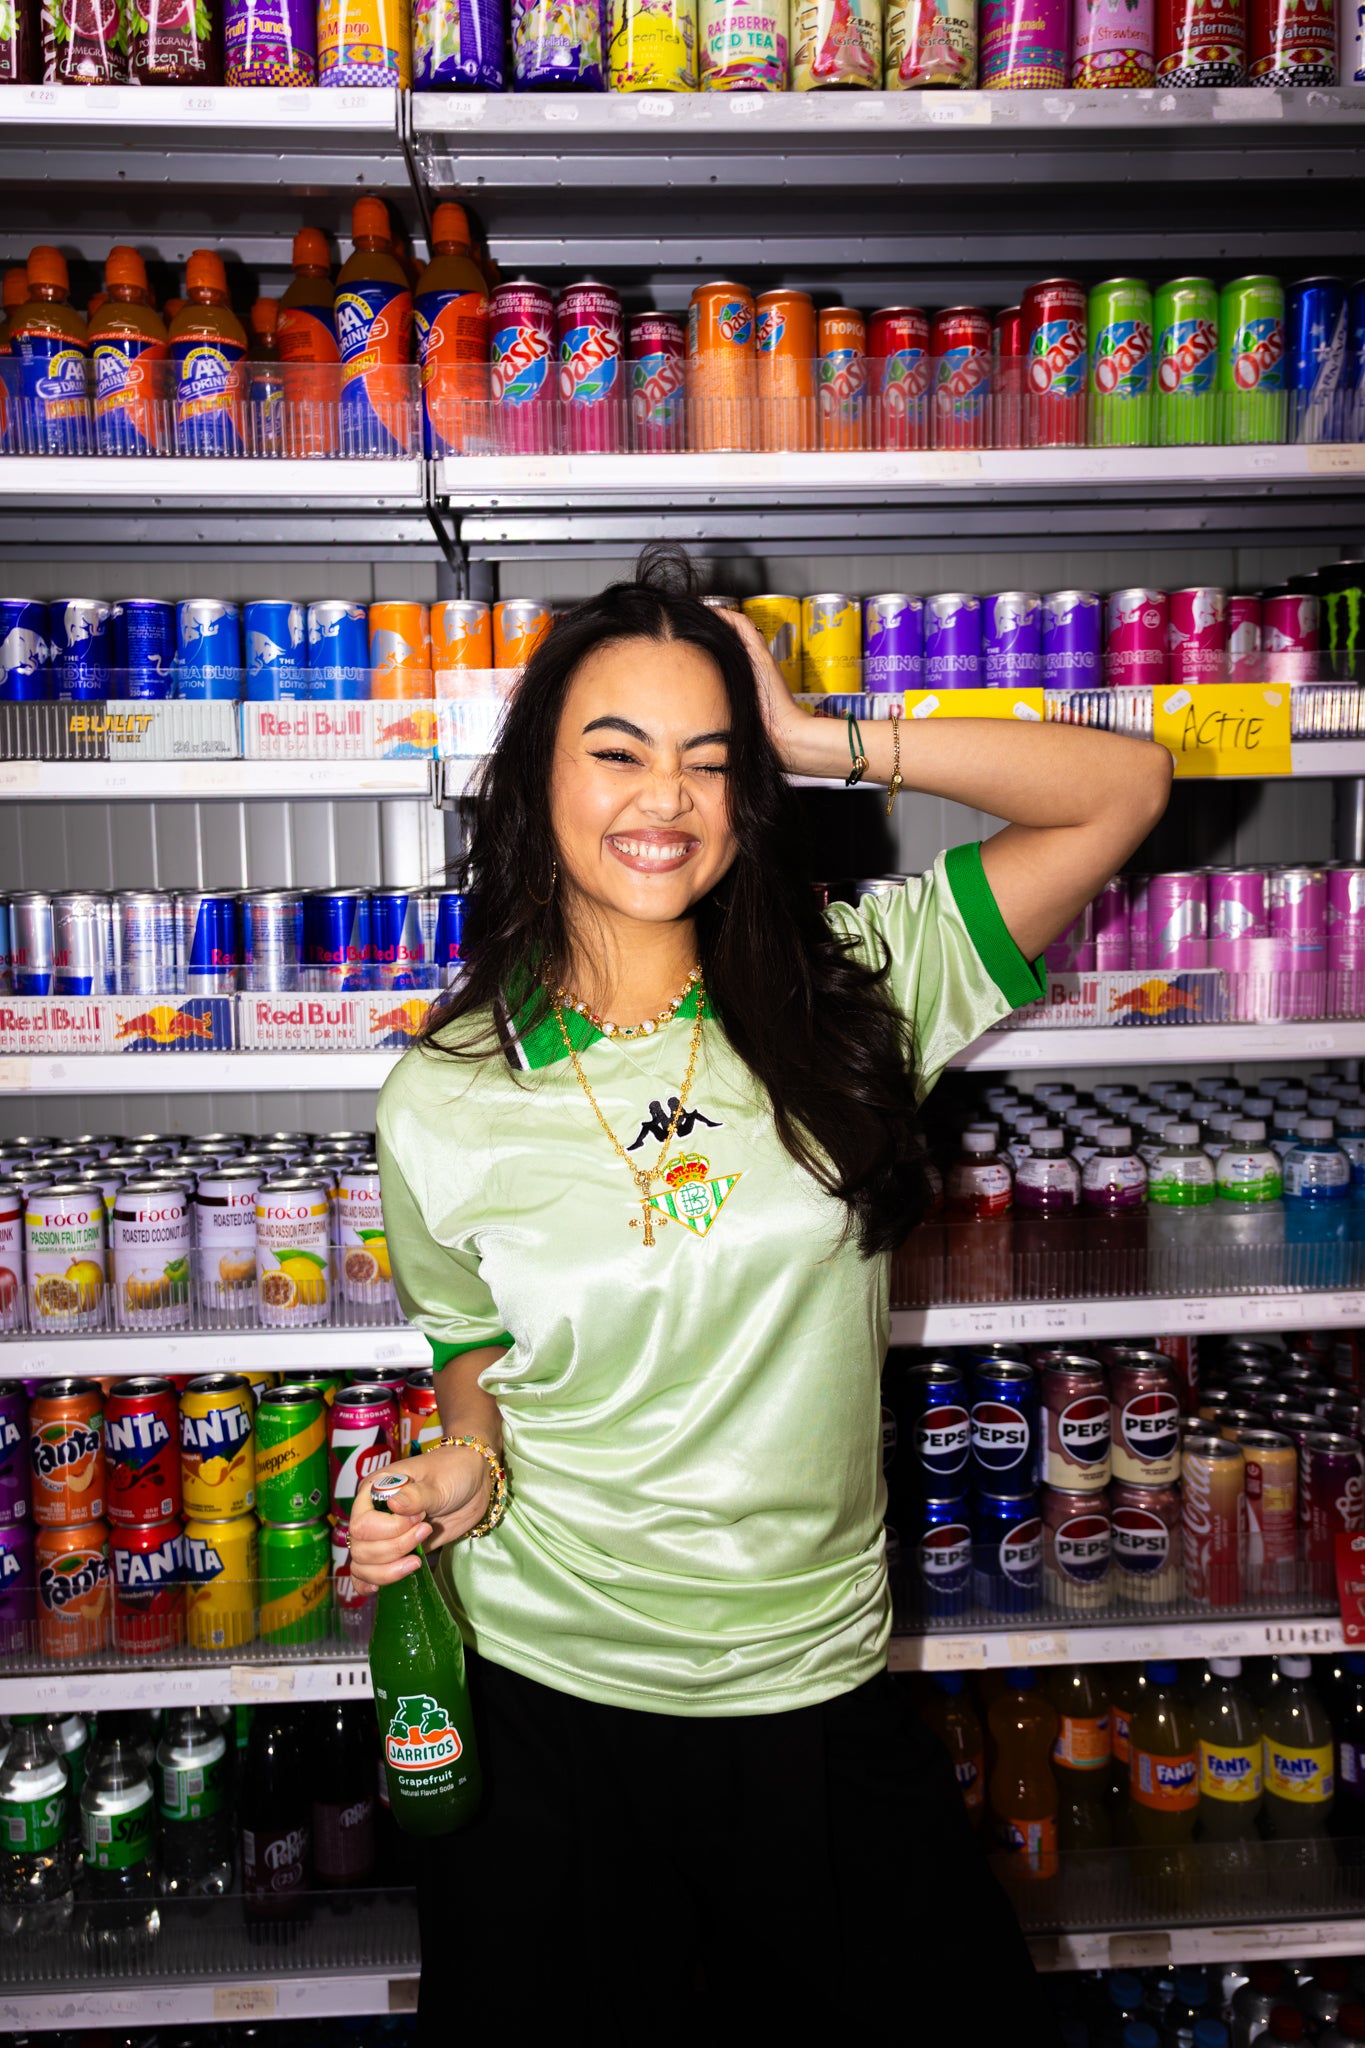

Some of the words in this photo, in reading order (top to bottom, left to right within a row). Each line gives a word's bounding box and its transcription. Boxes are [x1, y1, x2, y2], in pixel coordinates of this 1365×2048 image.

[934, 16, 969, 30] ZERO
[748, 33, 774, 50] TEA
[498, 298, 519, 308] CASSIS
[569, 298, 591, 309] CASSIS
[337, 305, 364, 340] AA
[98, 356, 122, 379] AA
[194, 358, 222, 379] AA
[490, 326, 550, 406] Oasis
[559, 326, 620, 405] Oasis
[191, 375, 229, 395] DRINK
[986, 647, 1000, 656] THE
[1182, 641, 1199, 649] THE
[63, 655, 79, 663] THE
[279, 657, 295, 666] THE
[986, 671, 1020, 682] EDITION
[1182, 664, 1219, 675] EDITION
[63, 681, 102, 691] EDITION
[260, 711, 310, 737] Red
[314, 710, 361, 736] Bull
[316, 945, 344, 963] Red
[397, 943, 425, 962] Bull
[1051, 982, 1097, 1006] Bull
[0, 1006, 48, 1032] Red
[51, 1006, 101, 1031] Bull
[256, 1002, 304, 1026] Red
[309, 1002, 355, 1026] Bull
[45, 1211, 90, 1228] FOCO
[139, 1206, 181, 1224] FOCO
[213, 1211, 242, 1229] ROASTED
[267, 1205, 309, 1221] FOCO
[31, 1230, 60, 1246] PASSION
[61, 1229, 83, 1245] FRUIT
[122, 1228, 151, 1245] ROASTED
[151, 1225, 180, 1244] COCONUT
[1062, 1418, 1111, 1438] PEPS
[1125, 1416, 1178, 1434] PEPS
[917, 1428, 969, 1448] PEPS
[1058, 1539, 1111, 1558] PEPS
[920, 1549, 970, 1568] PEPS
[389, 1740, 454, 1762] JARRITOS
[398, 1769, 453, 1789] Grapefruit
[400, 1787, 419, 1798] Natural
[420, 1786, 438, 1798] Flavor
[439, 1783, 455, 1794] Soda
